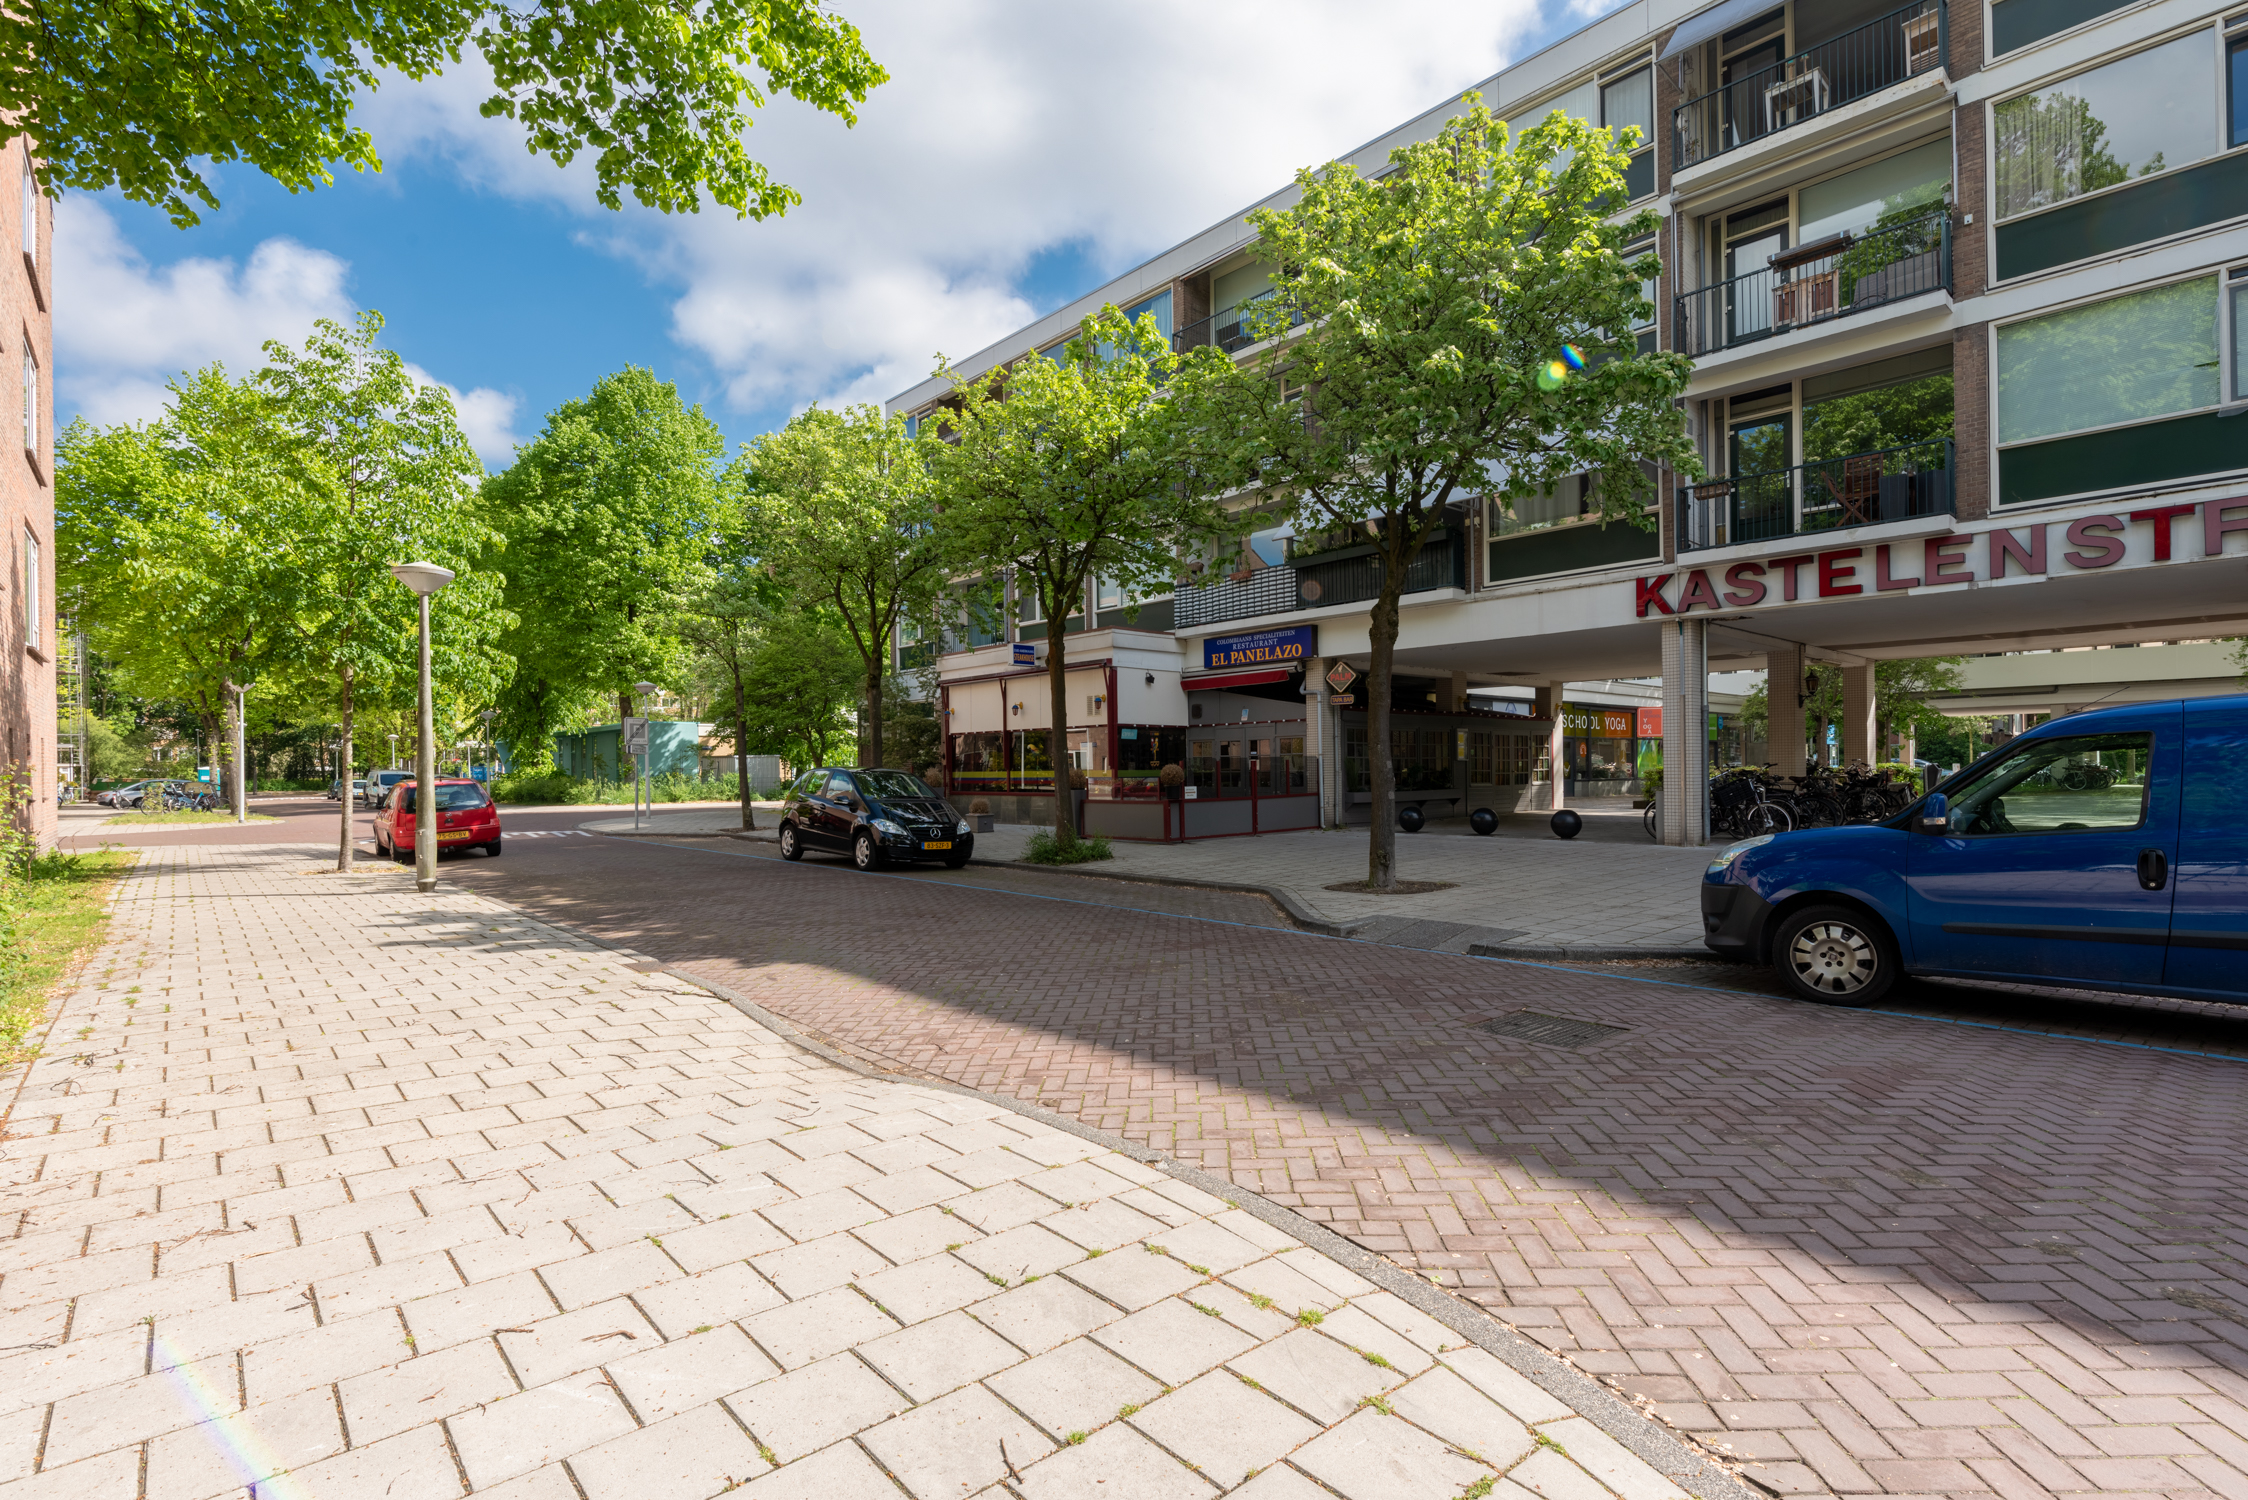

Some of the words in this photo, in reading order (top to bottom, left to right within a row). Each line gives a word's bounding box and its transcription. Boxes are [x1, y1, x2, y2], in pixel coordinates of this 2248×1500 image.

[1216, 635, 1252, 646] COLOMBIAANS
[1253, 630, 1296, 641] SPECIALITEITEN
[1232, 638, 1278, 650] RESTAURANT
[1211, 653, 1228, 666] EL
[1230, 643, 1303, 665] PANELAZO
[1330, 672, 1352, 682] PALM
[1604, 717, 1627, 731] YOGA
